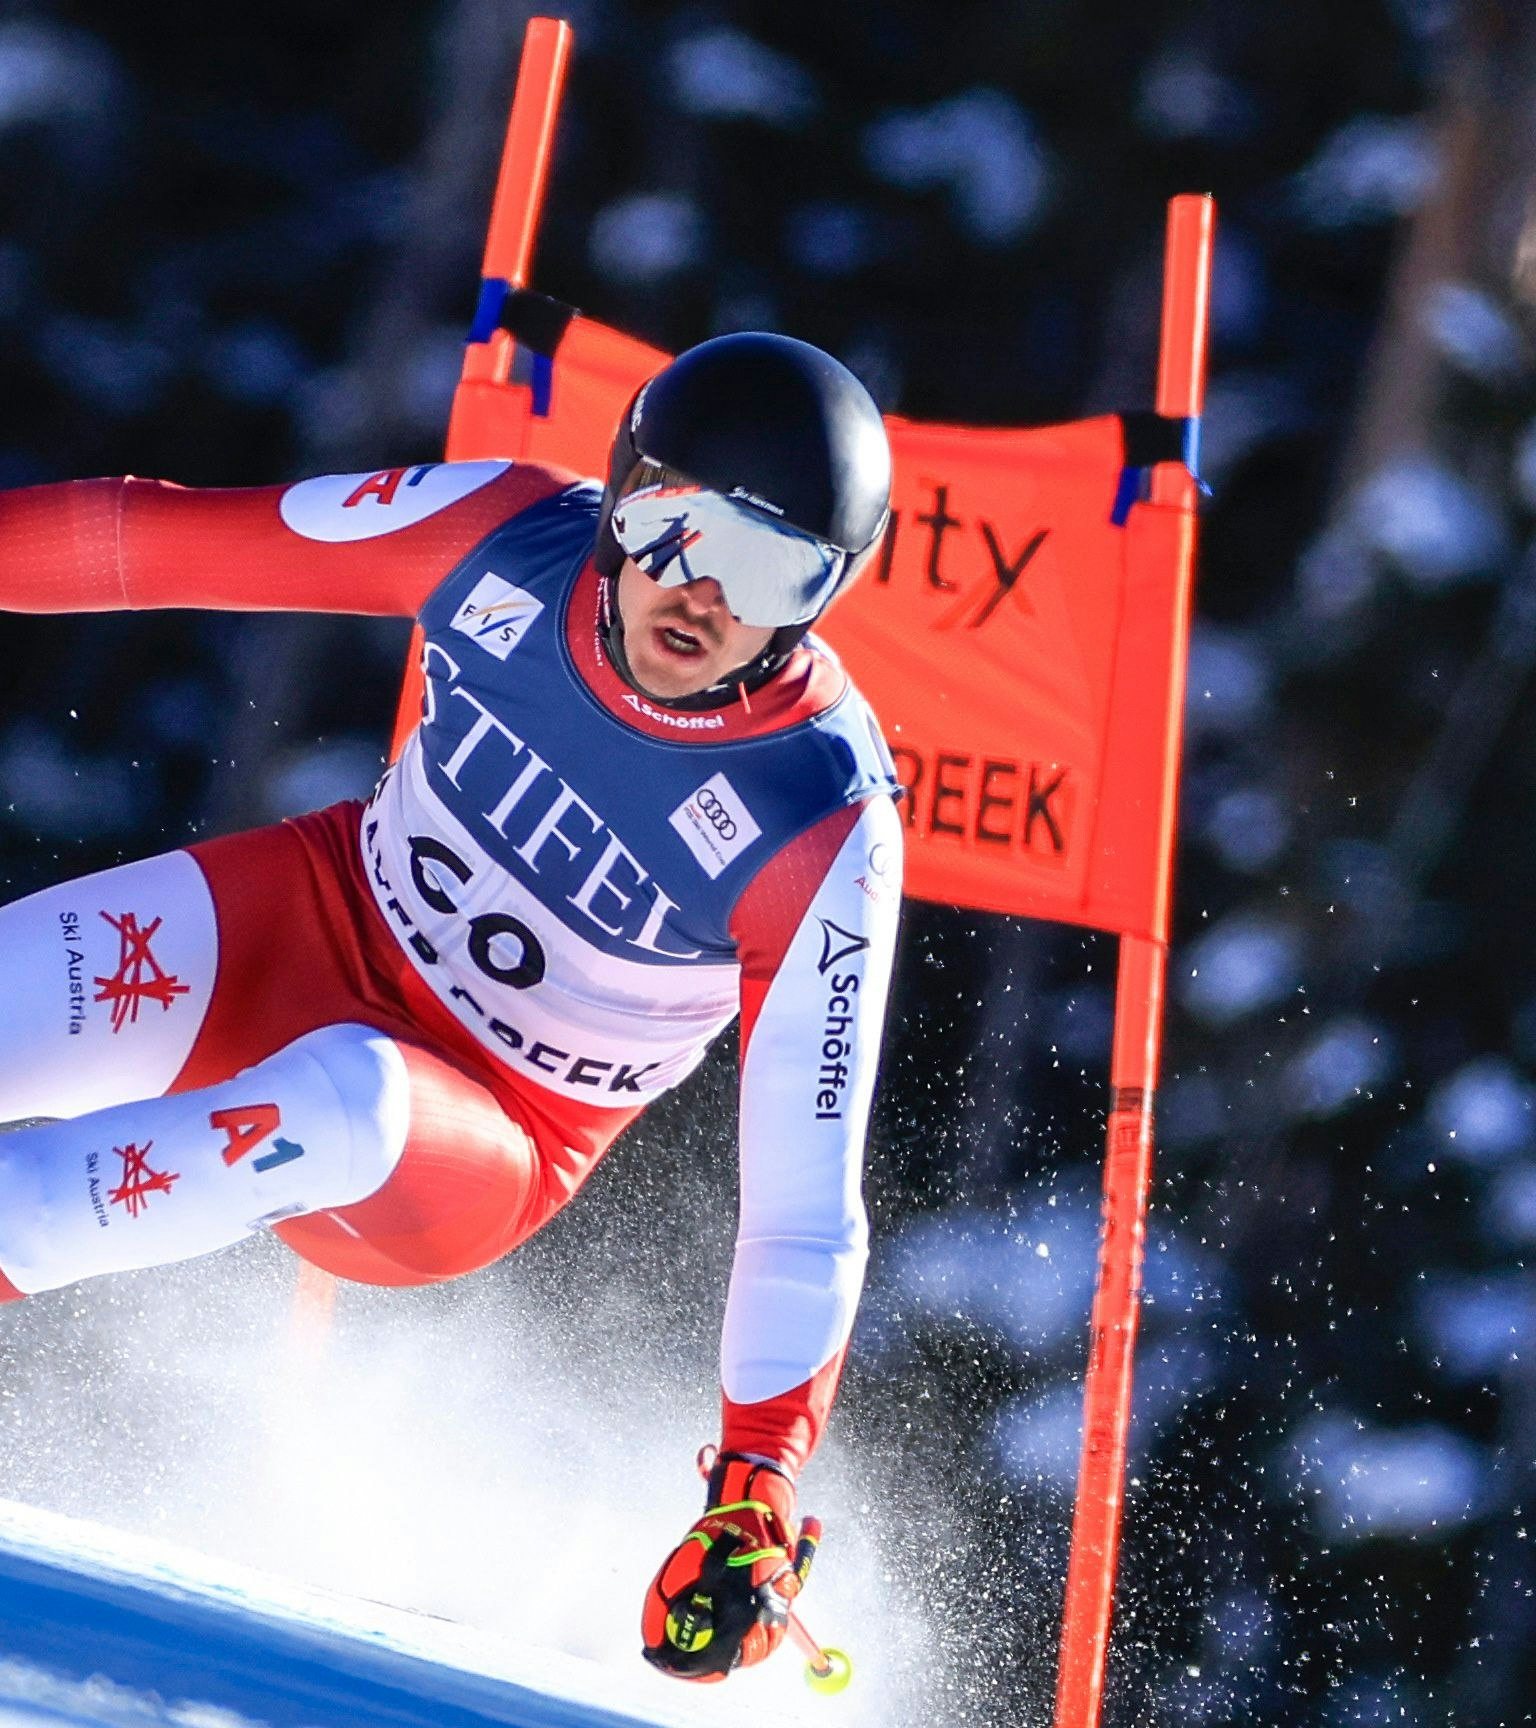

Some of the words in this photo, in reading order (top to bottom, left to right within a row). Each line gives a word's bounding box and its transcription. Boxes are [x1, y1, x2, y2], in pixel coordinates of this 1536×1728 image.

[421, 640, 702, 959] STIFEL
[853, 875, 880, 904] Aud
[59, 911, 78, 942] Ski
[66, 948, 87, 1036] Austria
[86, 1151, 99, 1174] Ski
[210, 1102, 306, 1173] A1
[87, 1175, 110, 1228] Austria
